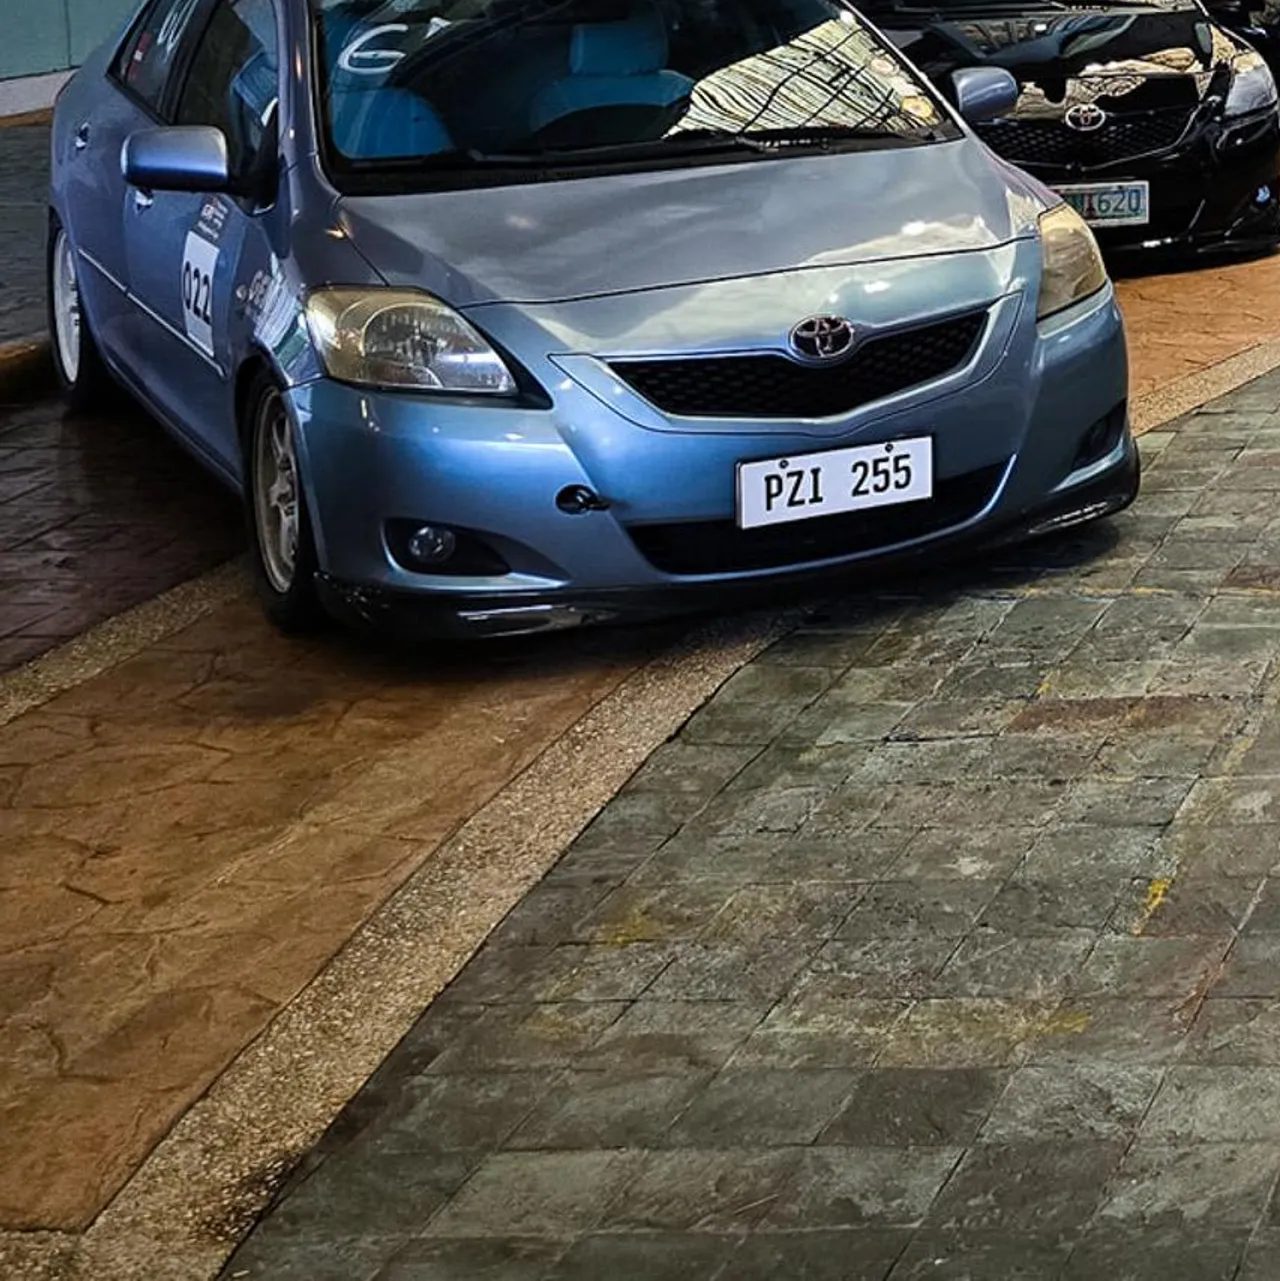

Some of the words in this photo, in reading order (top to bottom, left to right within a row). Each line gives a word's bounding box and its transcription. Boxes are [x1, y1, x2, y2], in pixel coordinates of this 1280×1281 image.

[1097, 189, 1141, 213] 620
[183, 260, 211, 325] 022
[764, 467, 824, 511] PZI
[851, 454, 912, 497] 255
